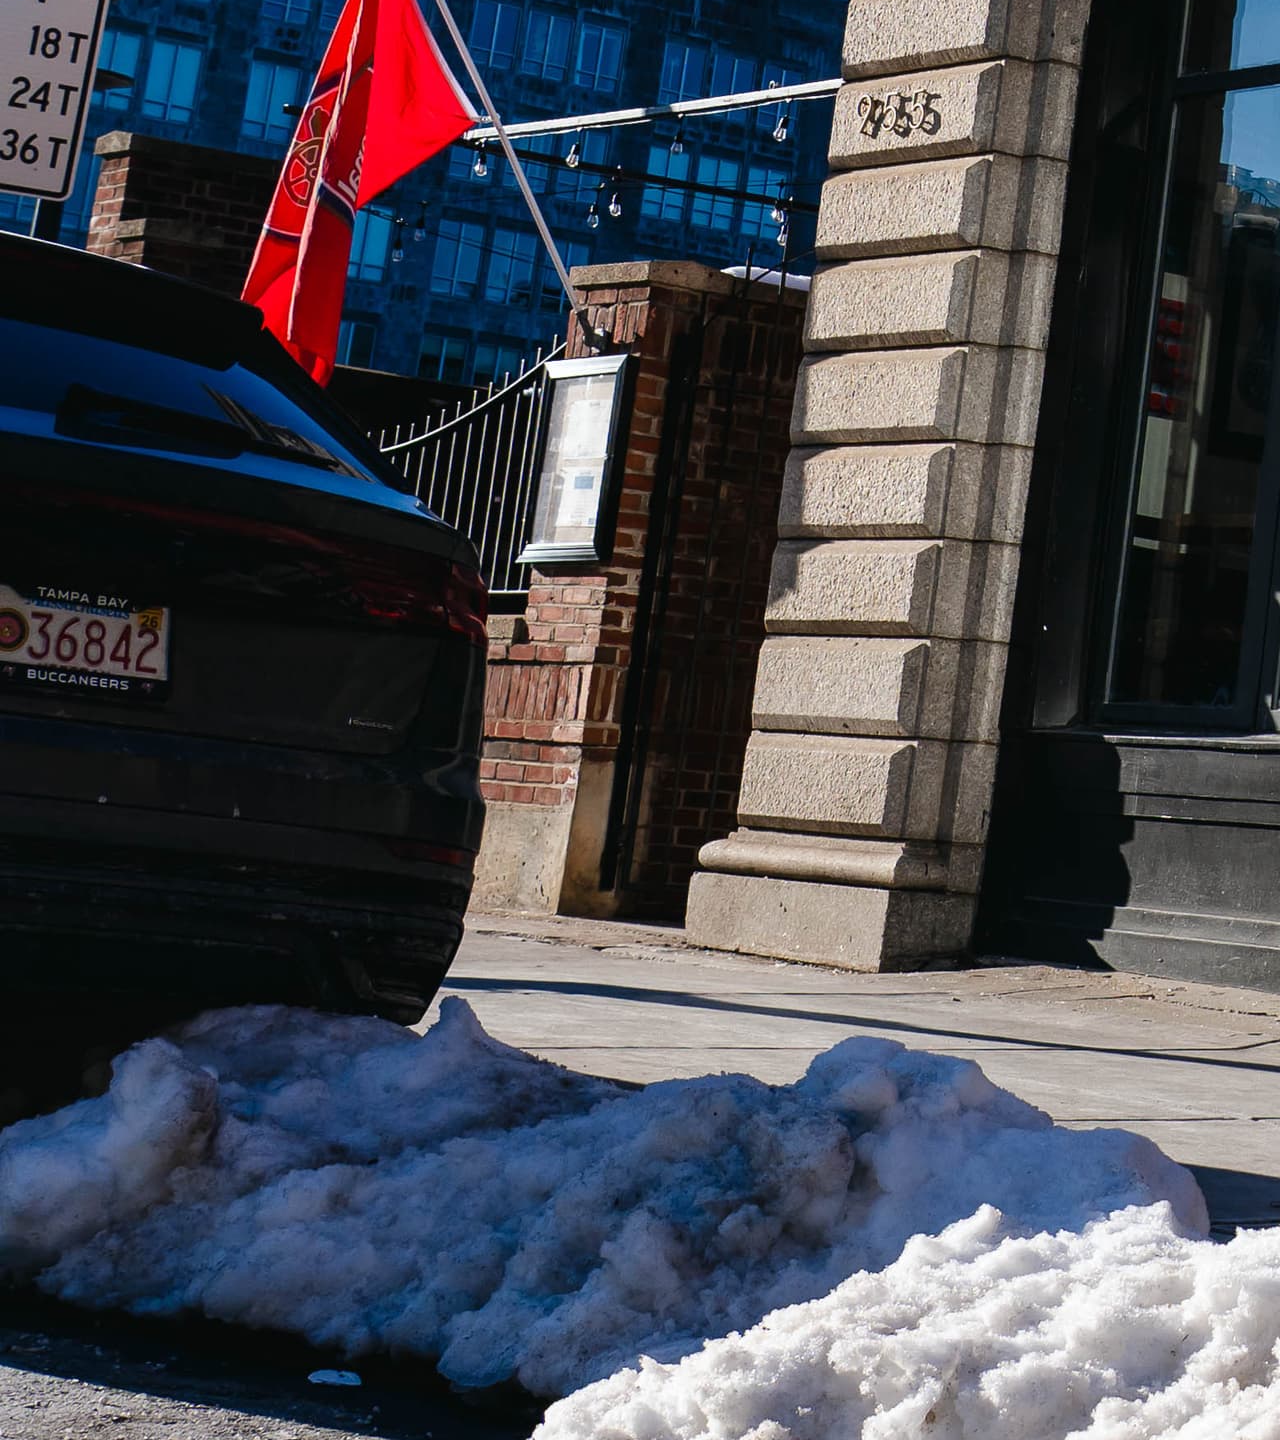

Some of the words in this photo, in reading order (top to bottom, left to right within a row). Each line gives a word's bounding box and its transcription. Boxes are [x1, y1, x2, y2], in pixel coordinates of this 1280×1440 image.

[857, 89, 926, 132] 955
[37, 586, 90, 604] TAMPA
[97, 595, 129, 609] BAY
[141, 615, 158, 628] 26
[28, 611, 160, 674] 36842
[26, 669, 130, 690] BUCCANEERS
